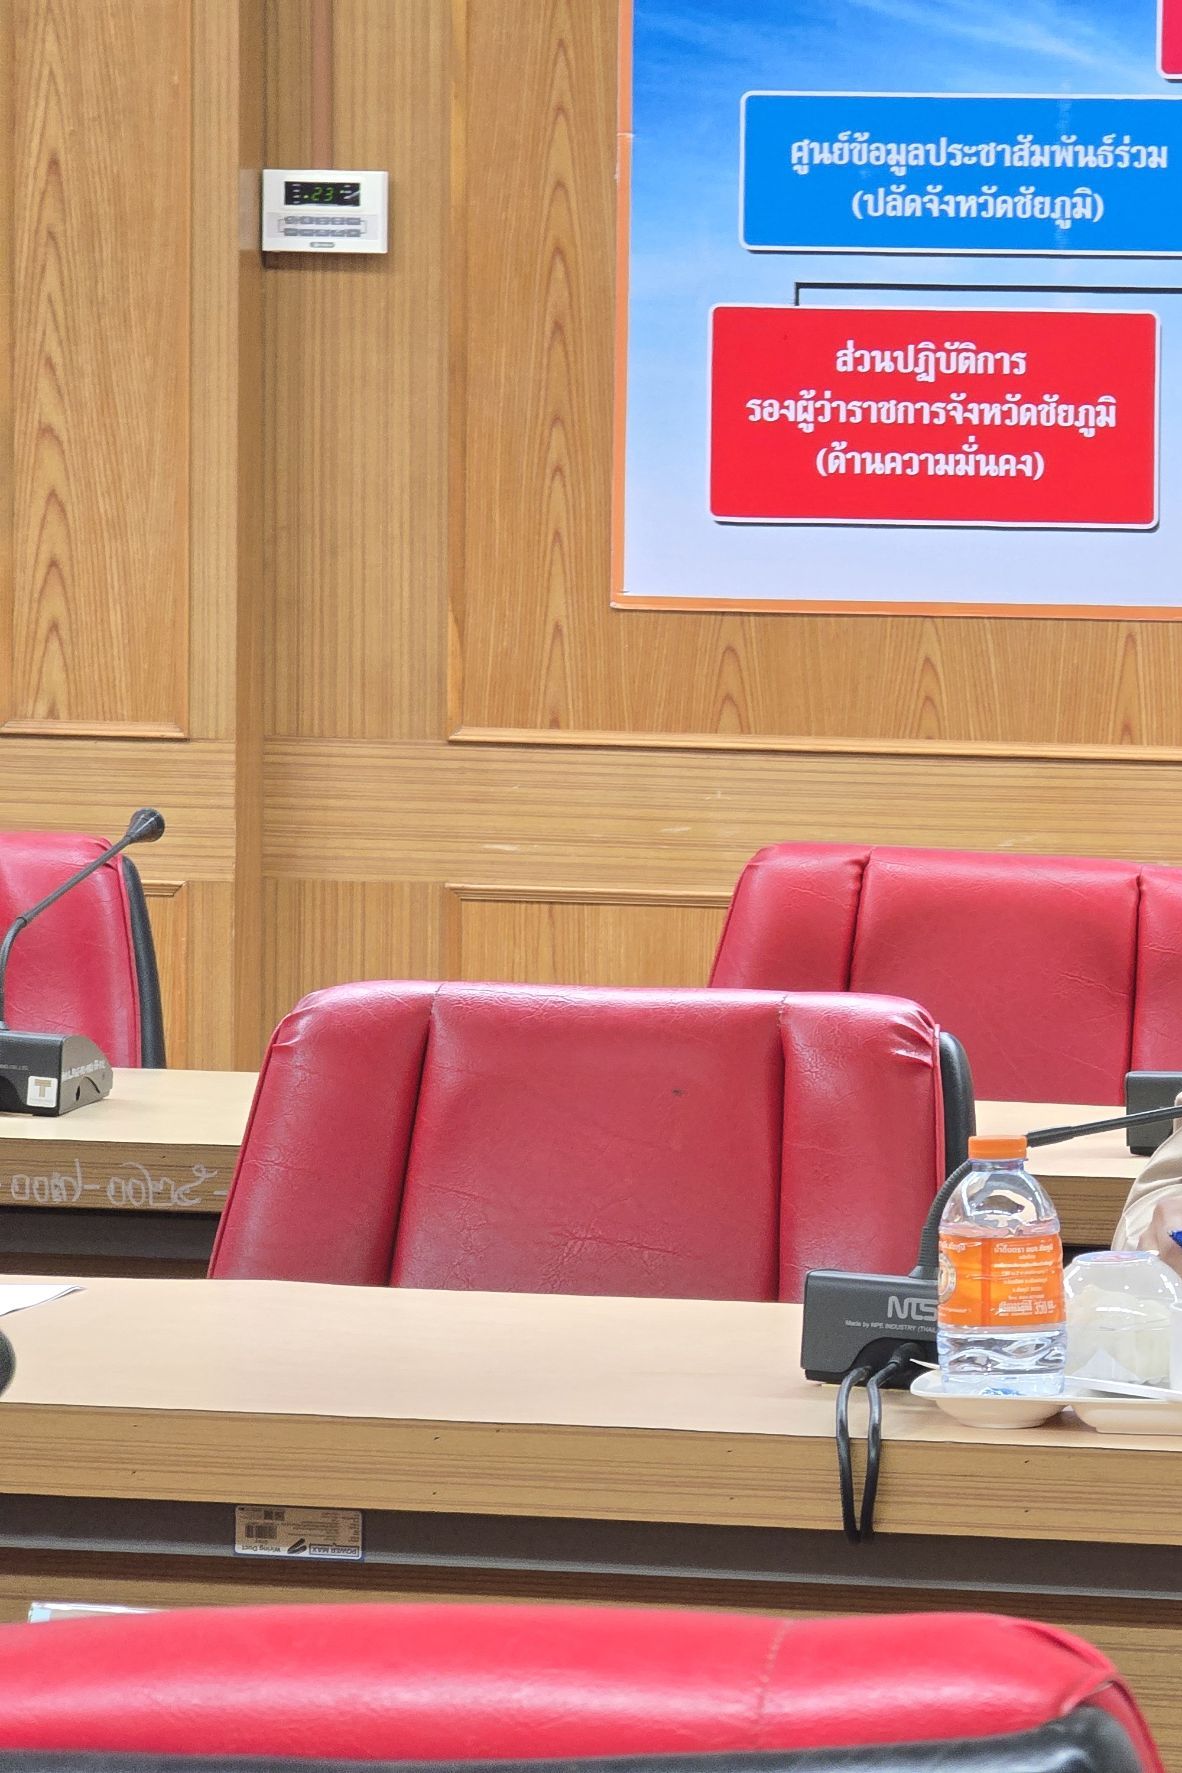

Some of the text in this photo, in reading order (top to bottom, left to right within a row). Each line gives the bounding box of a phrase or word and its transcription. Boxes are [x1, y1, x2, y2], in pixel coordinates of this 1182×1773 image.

[791, 131, 1168, 175] ศูนย์ข้อมูลประชาสัมพันธ์ร่วม
[851, 185, 1103, 230] (ปลัดจังหวัดชัยภูมิ)
[836, 340, 1027, 383] ส่วนปฏิบัติการ
[746, 390, 1117, 437] รองผู้ว่าราชการจังหวัดชัยภูมิ
[816, 436, 1045, 481] (ด้านความมั่นคง)
